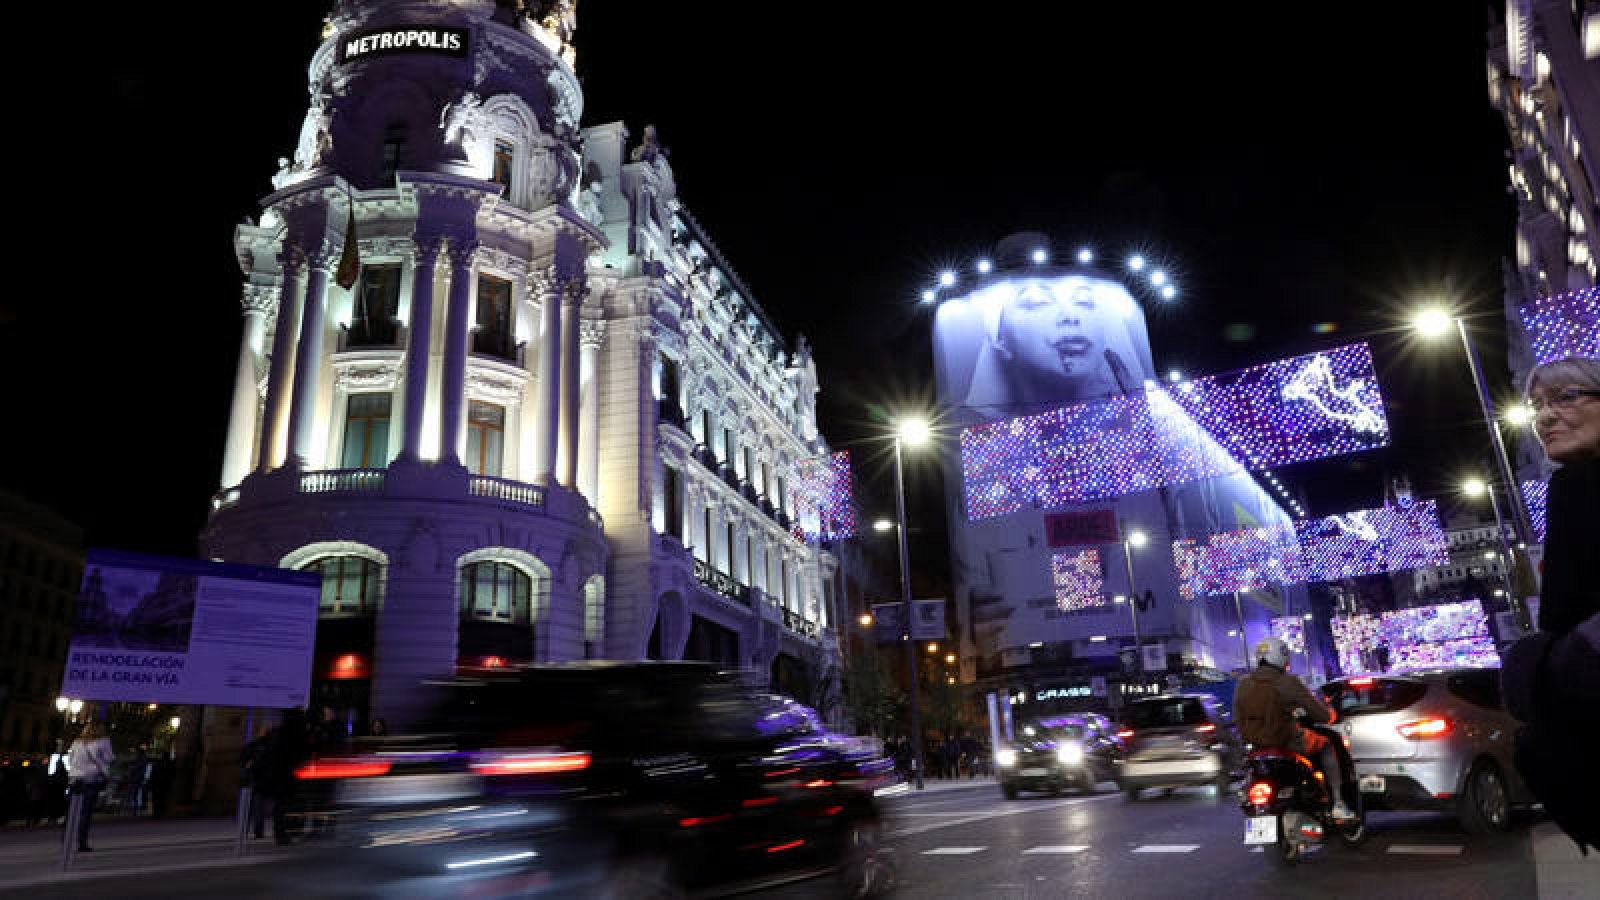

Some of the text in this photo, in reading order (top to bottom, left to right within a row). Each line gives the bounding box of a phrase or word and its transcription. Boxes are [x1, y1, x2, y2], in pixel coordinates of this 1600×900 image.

[345, 30, 461, 58] METROPOLIS
[71, 652, 185, 670] REMODELACIÓN
[69, 669, 88, 681] DE
[91, 670, 108, 682] LA
[111, 671, 152, 683] GRAN
